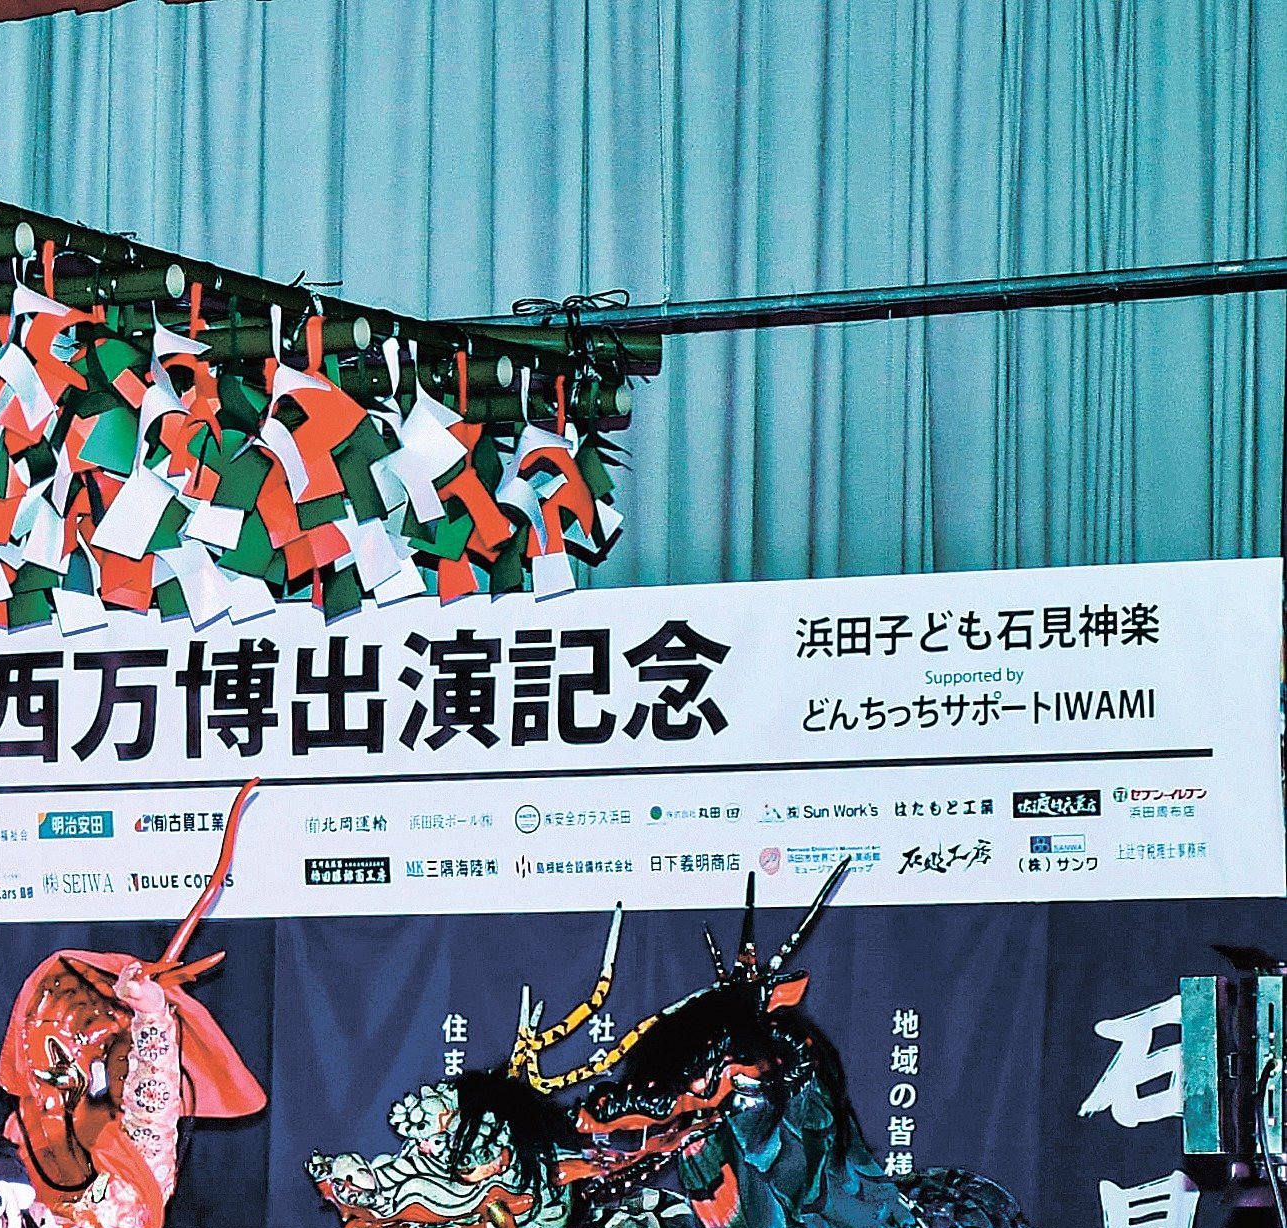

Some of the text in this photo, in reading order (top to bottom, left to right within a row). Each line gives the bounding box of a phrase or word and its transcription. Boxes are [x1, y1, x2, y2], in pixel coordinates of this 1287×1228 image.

[795, 602, 1161, 658] 浜田子ども石見神楽
[924, 666, 1024, 685] Supported by
[802, 688, 1156, 733] どんちっちサポートIWAMI
[803, 805, 830, 819] Sun
[833, 803, 879, 818] Work's
[51, 816, 104, 835] 明治安田
[650, 853, 741, 873] 日下義明商店
[62, 872, 115, 894] SEIWA
[141, 873, 235, 889] BLUE COS
